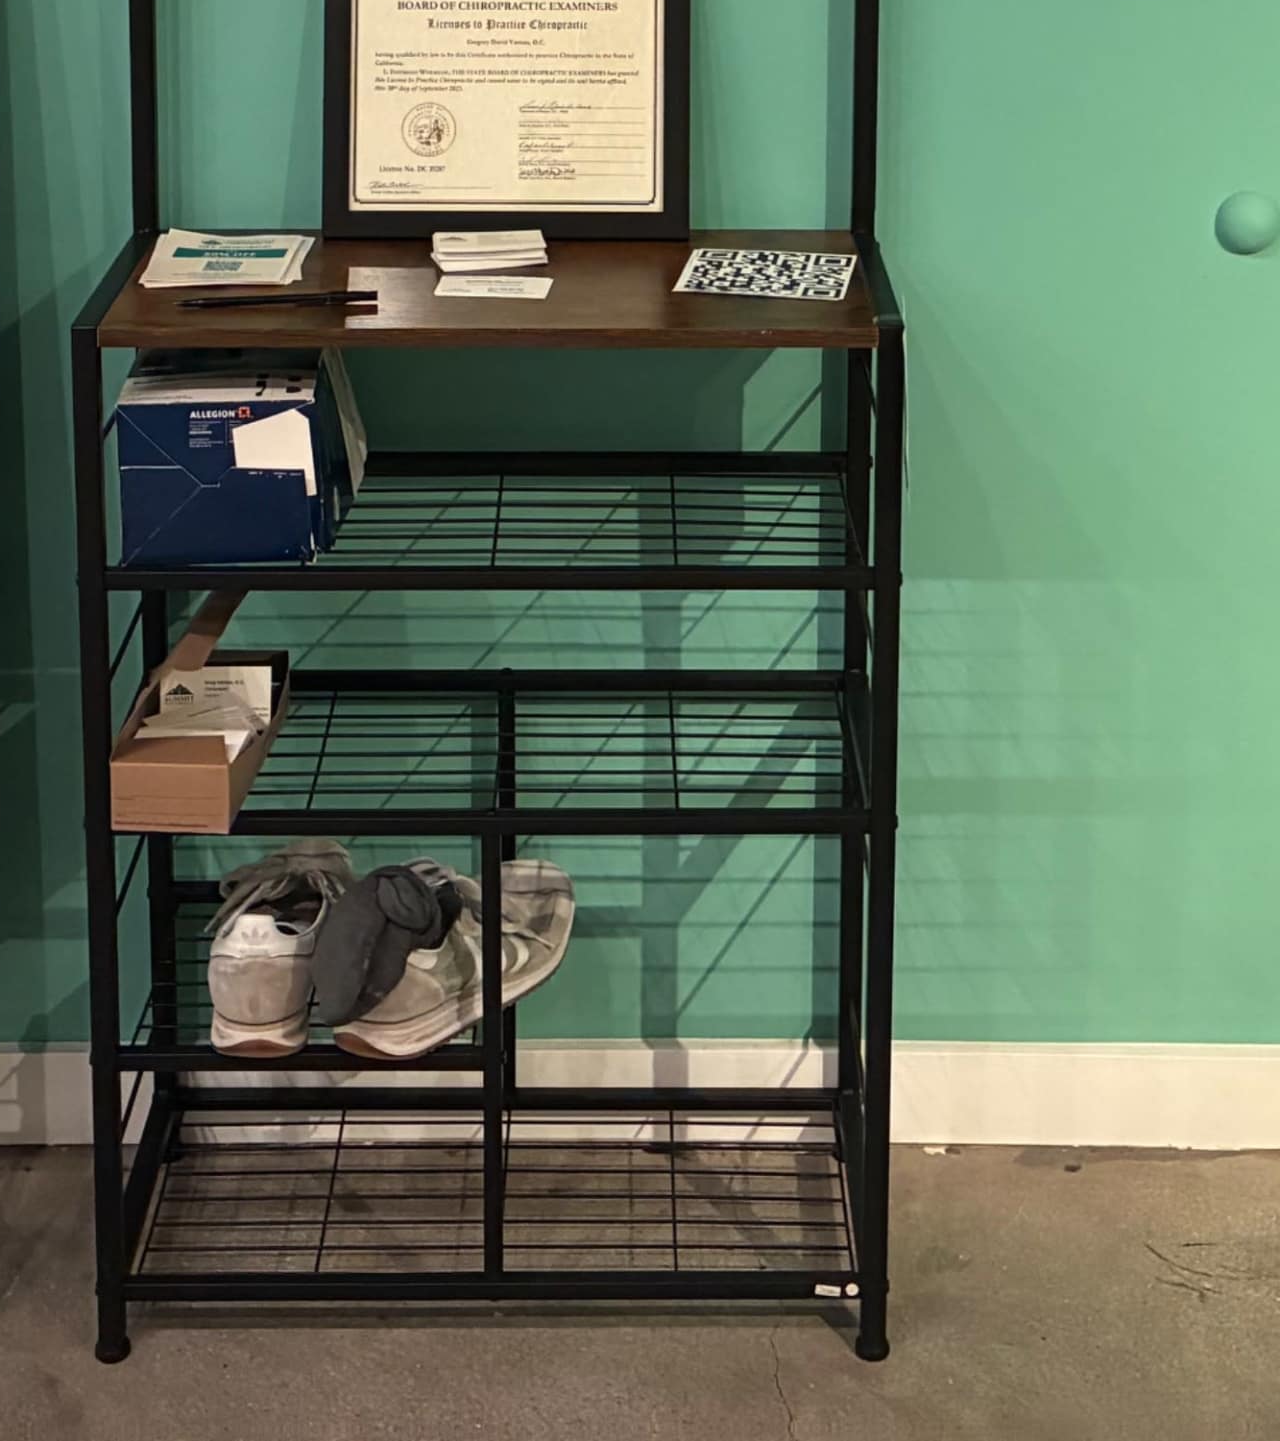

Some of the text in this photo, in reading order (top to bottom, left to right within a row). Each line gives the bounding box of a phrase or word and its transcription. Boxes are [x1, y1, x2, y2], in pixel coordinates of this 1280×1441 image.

[397, 1, 618, 11] BOARD OF CHIROPRACTIC EXAMINERS
[189, 410, 236, 419] ALLEGION
